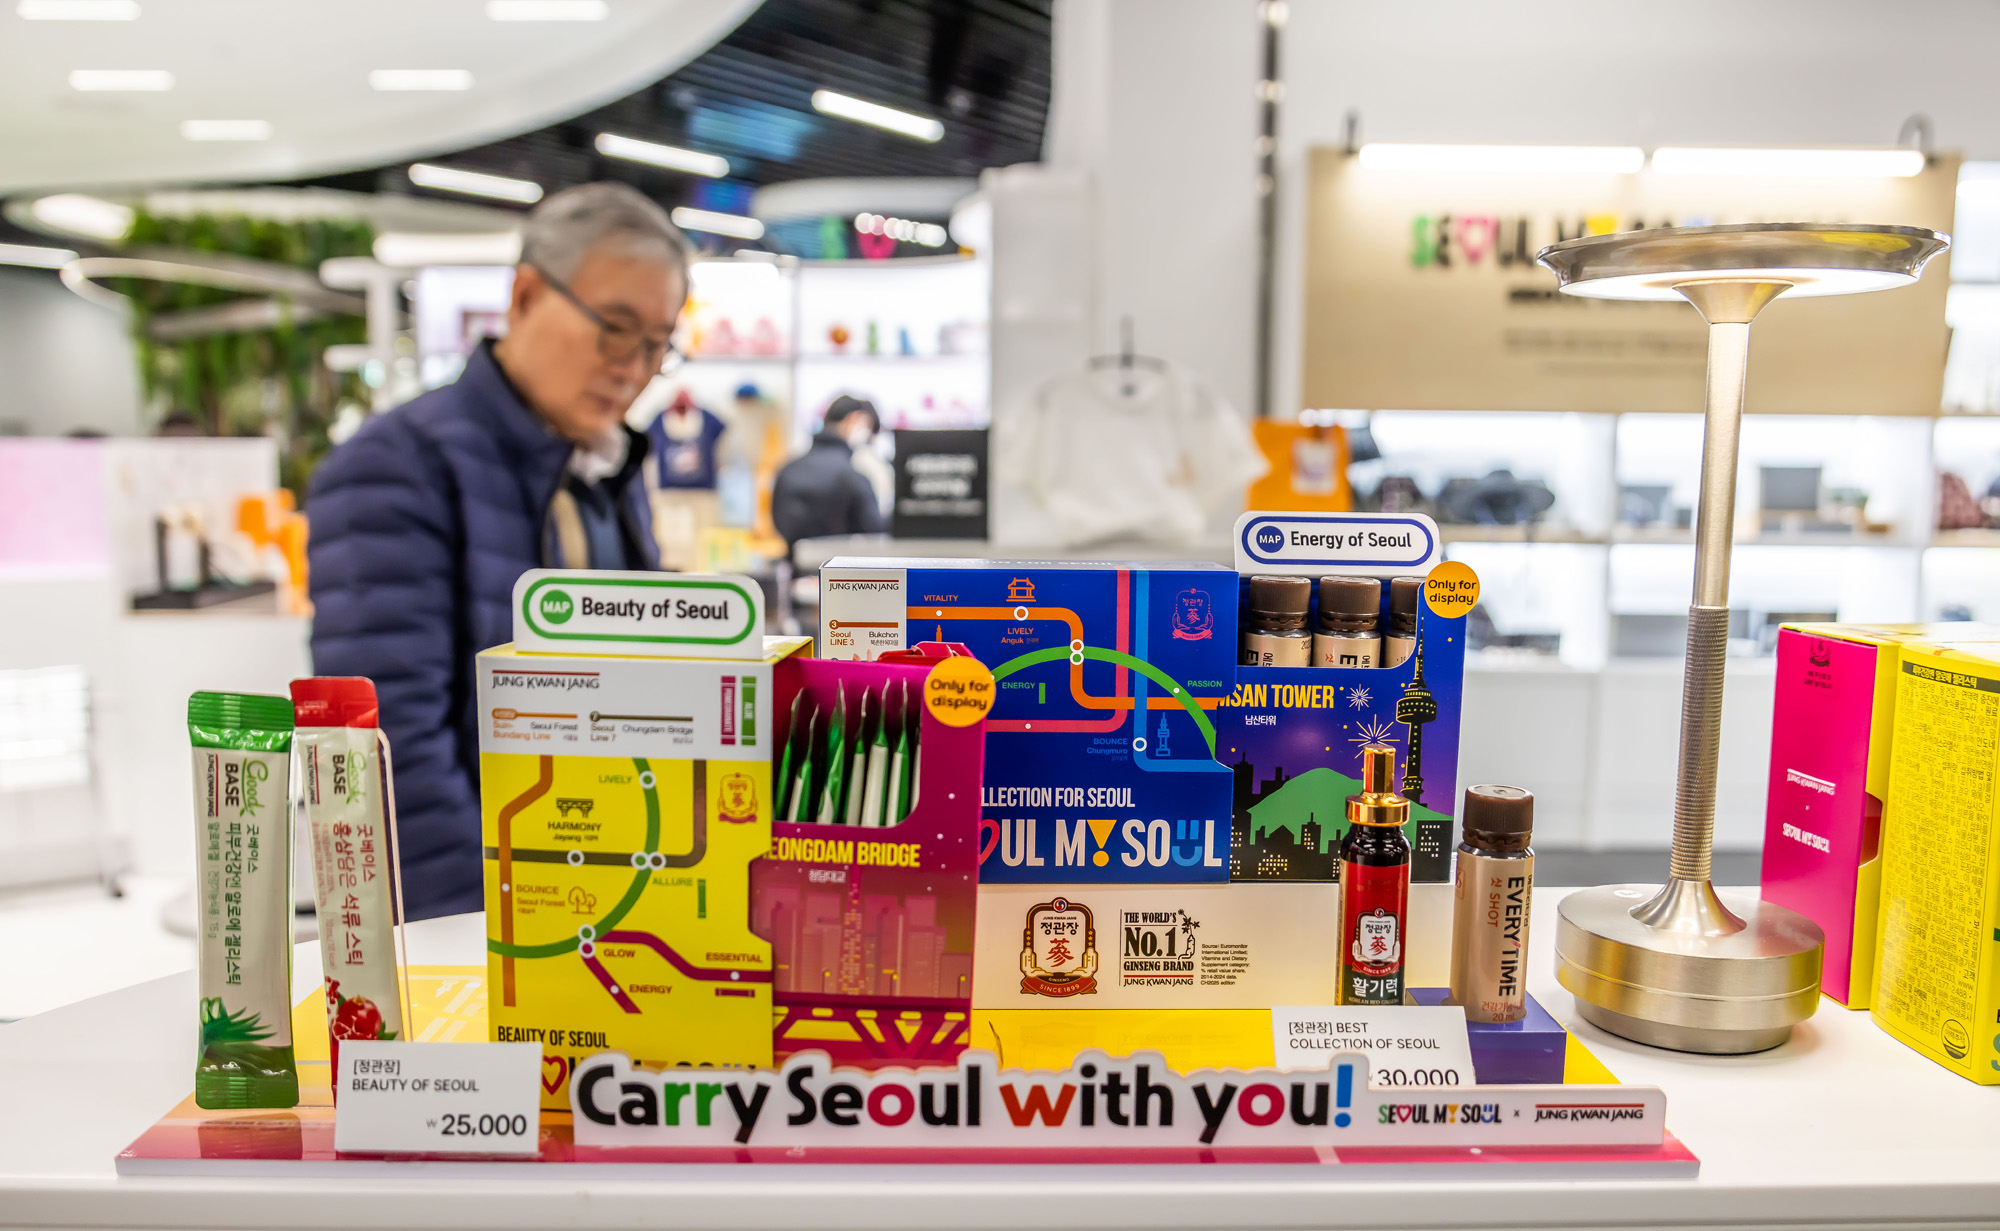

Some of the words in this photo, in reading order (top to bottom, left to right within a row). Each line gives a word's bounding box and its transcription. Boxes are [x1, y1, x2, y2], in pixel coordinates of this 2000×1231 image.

[1259, 535, 1282, 544] MAP
[1291, 531, 1344, 550] Energy
[1349, 532, 1364, 546] of
[1368, 532, 1412, 548] Seoul
[829, 583, 850, 592] JUNG
[852, 583, 877, 592] KWAN
[878, 583, 899, 592] JANG
[1428, 580, 1456, 592] Only
[1460, 580, 1477, 589] for
[1430, 593, 1474, 606] display
[543, 602, 570, 613] MAP
[582, 597, 645, 621] Beauty
[652, 599, 670, 618] of
[676, 600, 729, 620] Seoul
[1001, 637, 1024, 645] Anguk
[492, 676, 524, 688] JUNG
[527, 677, 565, 689] KWAN
[567, 678, 600, 690] JANG
[930, 679, 964, 694] Only
[970, 680, 990, 692] for
[1002, 682, 1035, 690] ENERGY
[1188, 680, 1222, 688] PASSION
[1271, 684, 1334, 708] TOWER
[932, 696, 988, 710] display
[530, 722, 552, 730] Seoul
[554, 722, 578, 731] Forest
[1244, 714, 1277, 726] 남산타워
[590, 723, 614, 732] Seoul
[493, 731, 530, 741] Bundang
[533, 732, 551, 740] Line
[590, 734, 609, 742] Line
[611, 734, 616, 742] 7
[1086, 747, 1128, 755] Chungmuro
[333, 754, 346, 795] BASE
[352, 751, 367, 795] Good
[599, 774, 632, 785] LIVELY
[225, 763, 239, 807] BASE
[246, 759, 268, 808] Good
[980, 788, 1052, 807] LLECTION
[1055, 788, 1084, 807] FOR
[1087, 788, 1136, 808] SEOUL
[548, 821, 602, 832] HARMONY
[246, 824, 259, 874] 굿베이스
[333, 820, 357, 888] 홍삼담은
[357, 824, 376, 882] 굿베이스
[764, 836, 853, 864] EONGDAM
[856, 841, 921, 868] BRIDGE
[652, 876, 693, 887] ALLURE
[516, 884, 558, 895] BOUNCE
[516, 896, 538, 906] Seoul
[225, 892, 242, 931] 알로에
[342, 893, 361, 928] 석류
[1488, 893, 1501, 928] SHOT
[1124, 912, 1140, 923] THE
[1142, 912, 1176, 923] WORLD'S
[1040, 922, 1079, 935] 정관장
[1365, 924, 1392, 934] 정관장
[345, 931, 364, 966] 스틱
[603, 948, 636, 958] GLOW
[225, 934, 242, 985] 젤리스틱
[706, 952, 763, 963] ESSENTIAL
[1124, 961, 1160, 971] GINSENG
[1162, 961, 1194, 971] BRAND
[1364, 966, 1380, 974] SINCE
[629, 984, 672, 994] ENERGY
[1040, 984, 1062, 994] SINCE
[1064, 984, 1080, 992] 1899
[1124, 978, 1144, 987] JUNG
[1146, 978, 1172, 986] KWAN
[1172, 978, 1194, 987] JANG
[1352, 976, 1398, 998] 활기력
[1492, 1013, 1504, 1022] 20
[1289, 1022, 1332, 1036] [정관장]
[1336, 1023, 1368, 1034] BEST
[498, 1026, 546, 1044] BEAUTY
[550, 1029, 565, 1046] OF
[569, 1031, 610, 1048] SEOUL
[1290, 1038, 1373, 1050] COLLECTION
[1376, 1038, 1393, 1050] OF
[1397, 1038, 1440, 1050] SEOUL
[354, 1059, 400, 1075] [정관장]
[1378, 1069, 1459, 1085] 30,000
[352, 1079, 408, 1091] BEAUTY
[412, 1079, 430, 1091] OF
[434, 1079, 480, 1092] SEOUL
[578, 1065, 770, 1144] Carry
[787, 1065, 981, 1126] Seoul
[999, 1063, 1173, 1127] with
[1192, 1064, 1354, 1144] you!
[1460, 1104, 1502, 1123] SOUL
[1534, 1109, 1568, 1122] JUNG
[1570, 1109, 1610, 1122] KWAN
[1610, 1109, 1643, 1122] JANG
[442, 1114, 527, 1136] 25,000
